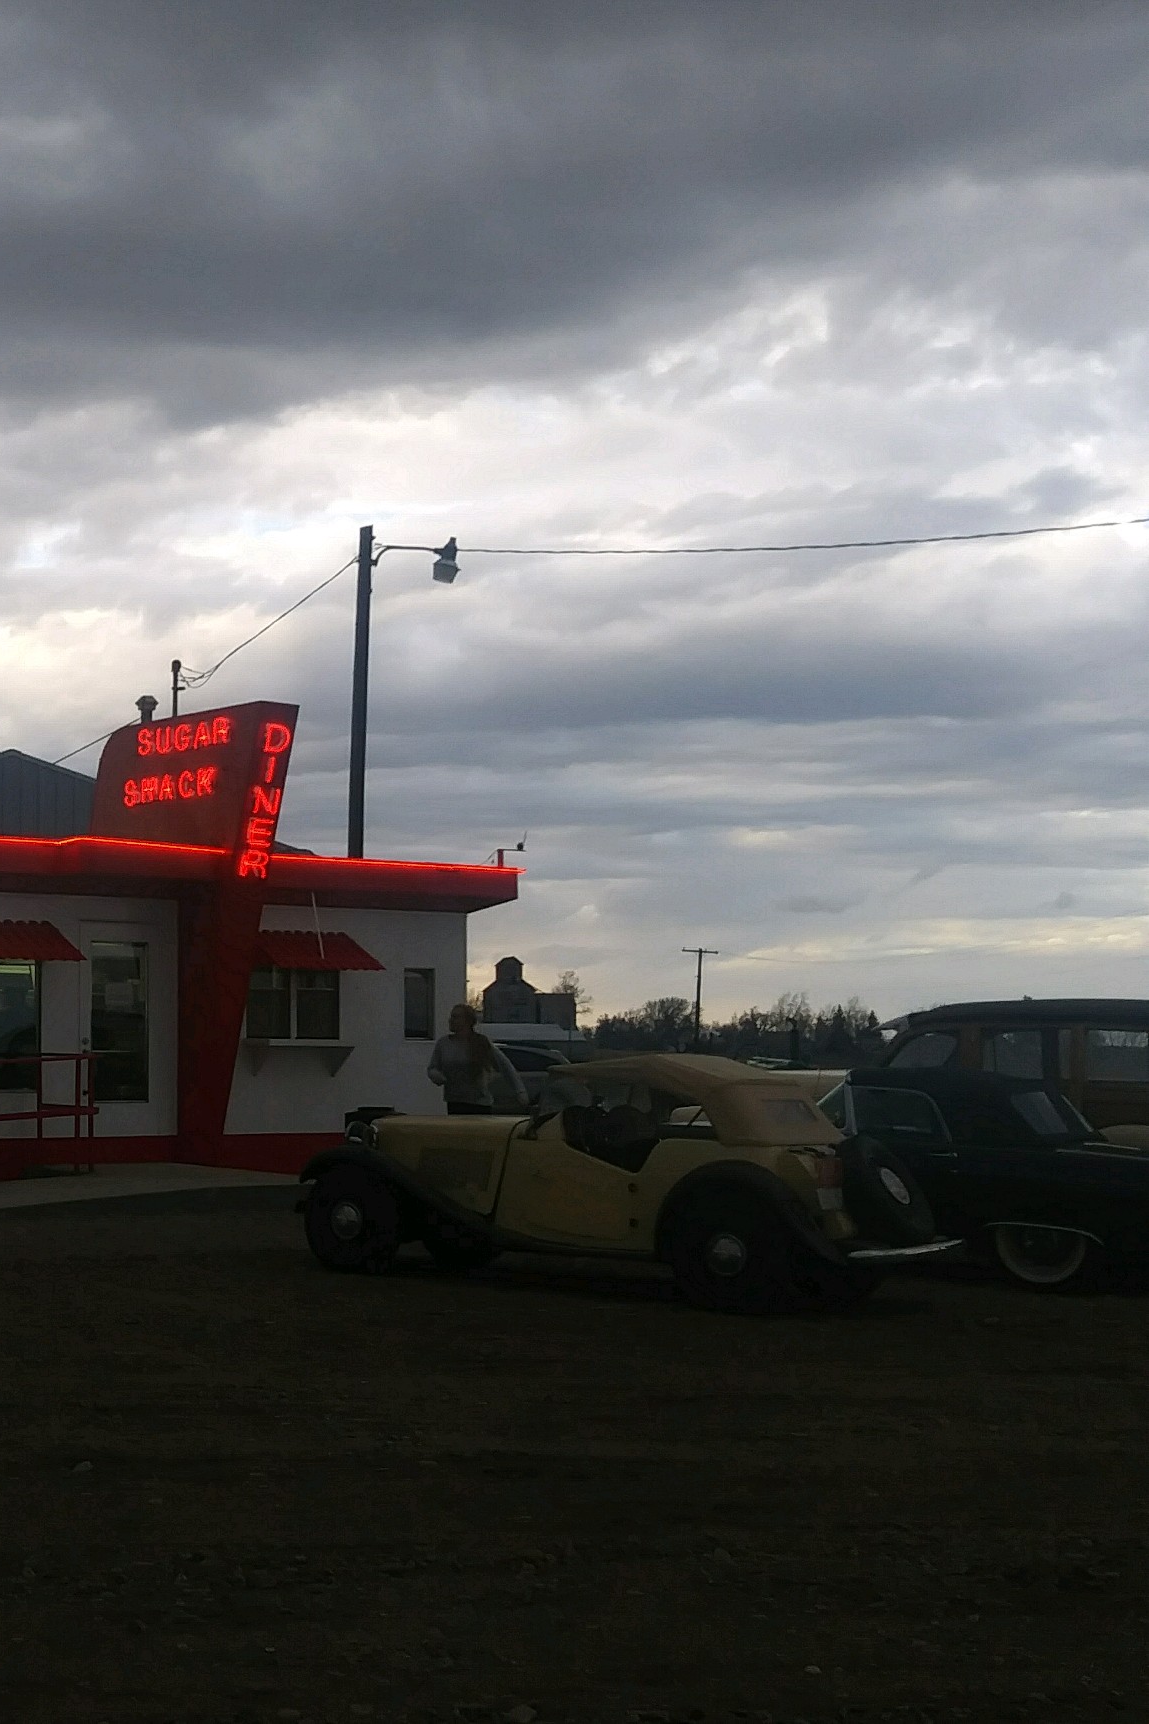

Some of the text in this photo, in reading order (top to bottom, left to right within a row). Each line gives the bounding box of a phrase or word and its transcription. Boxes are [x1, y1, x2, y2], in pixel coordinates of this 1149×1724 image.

[136, 716, 232, 757] SUGAR
[123, 766, 218, 808] SHACK
[237, 721, 292, 880] DINER
